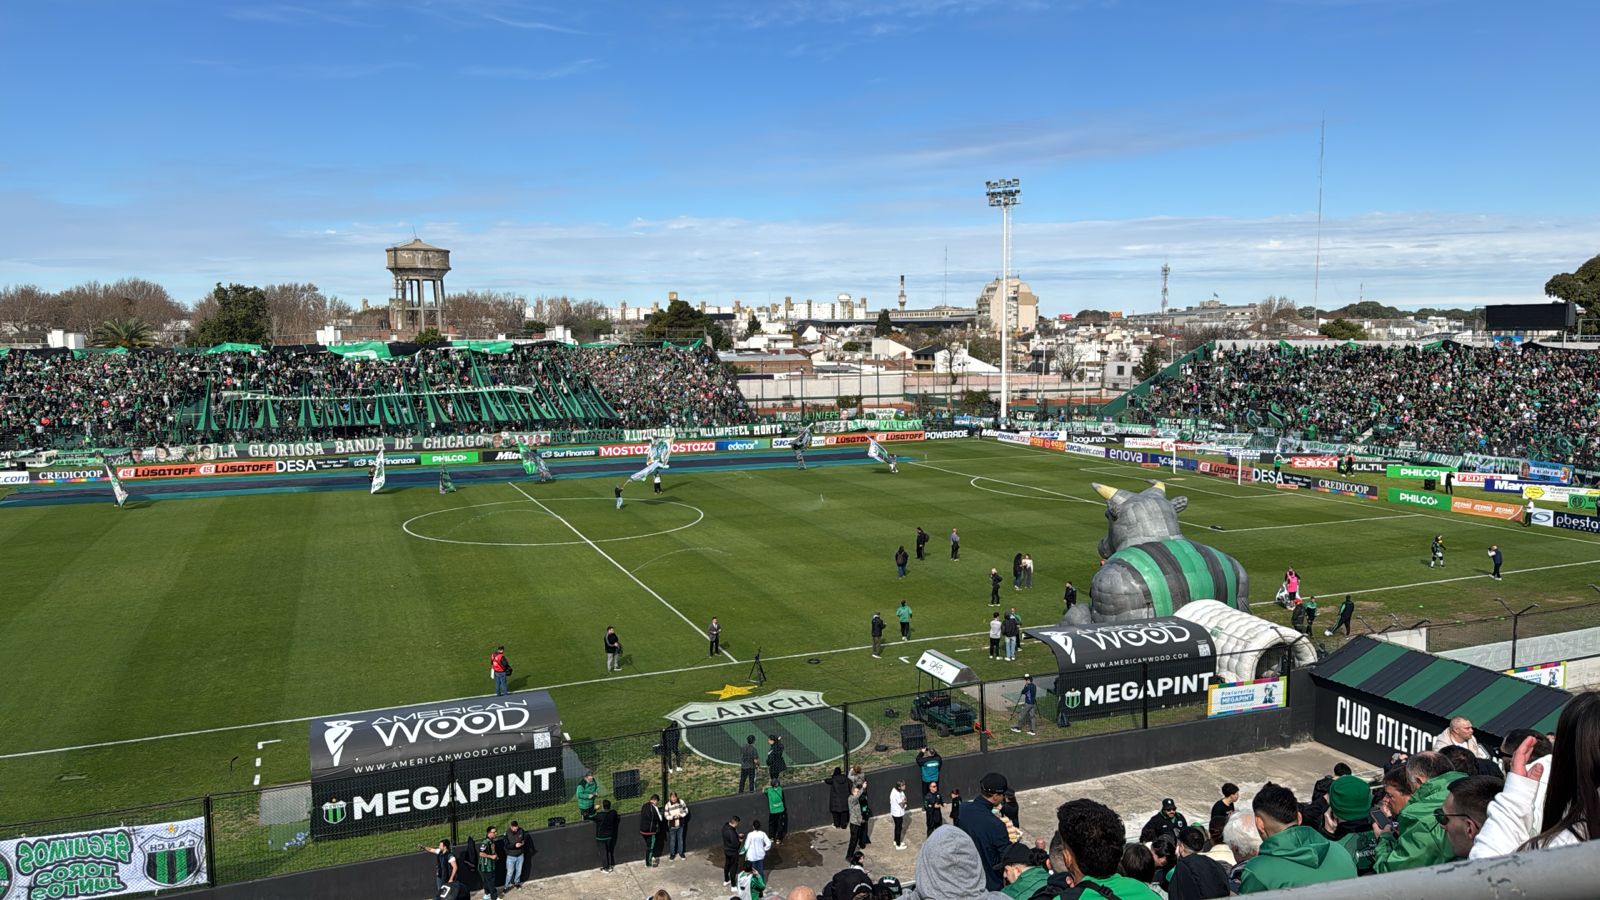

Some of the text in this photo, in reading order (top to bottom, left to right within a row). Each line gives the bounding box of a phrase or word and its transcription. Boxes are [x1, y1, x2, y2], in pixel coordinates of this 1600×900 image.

[924, 431, 969, 441] POWERADE
[218, 435, 485, 458] LA GLORIOSA BANDA DE CHICAGO
[554, 448, 595, 458] Sur Finanzas
[600, 445, 652, 457] MOSTAZ
[671, 442, 715, 452] OSTAZA
[727, 441, 755, 451] edenor
[432, 455, 464, 464] PHILCO
[1109, 448, 1143, 463] enova
[276, 460, 317, 472] DESA
[1400, 469, 1440, 478] PHILCO
[39, 469, 104, 480] CREDICOOP
[1252, 467, 1285, 484] DESA
[1318, 479, 1369, 494] CREDICOOP
[1399, 492, 1433, 505] PHILCO
[1080, 625, 1191, 650] WOOD
[1085, 653, 1190, 670] WWW.AMERICANWOOD.COM
[1084, 671, 1215, 707] MEGAPINT
[372, 699, 528, 726] AMERICAN
[372, 707, 530, 747] WOOD
[1336, 696, 1438, 755] CLUB ATLETIC
[353, 744, 518, 774] WWW.AMERICANWOOD.COM
[353, 767, 557, 820] MEGAPINT
